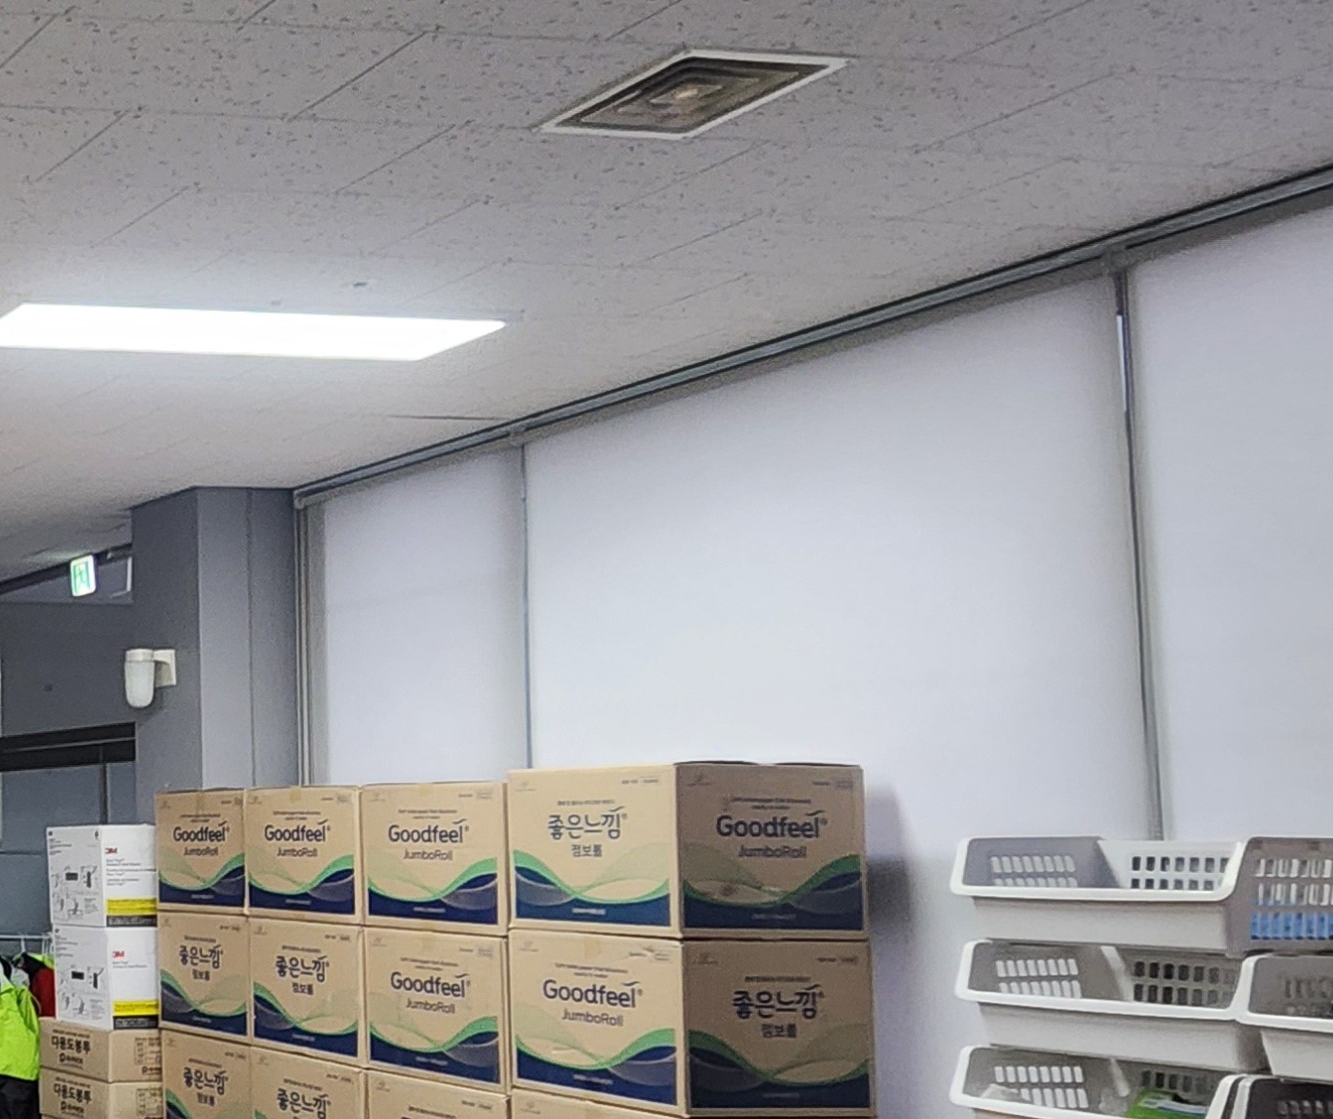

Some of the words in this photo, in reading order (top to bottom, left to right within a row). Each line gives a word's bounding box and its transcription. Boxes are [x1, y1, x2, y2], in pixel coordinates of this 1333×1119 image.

[173, 822, 227, 842] Goodfeel
[264, 820, 326, 842] Goodfeel
[388, 819, 465, 843] Goodfeel
[548, 806, 625, 840] 좋은느낌
[716, 810, 823, 838] Goodfeel
[403, 850, 453, 861] JumboRoll
[571, 844, 603, 858] 점보롤
[738, 845, 807, 858] JumboRoll
[179, 945, 222, 969] 좋은느낌
[275, 956, 328, 982] 좋은느낌
[390, 972, 467, 998] Goodfeel
[543, 979, 639, 1008] Goodfeel
[406, 998, 455, 1014] JumboRoll
[733, 984, 821, 1020] 좋은느낌
[562, 1008, 624, 1027] JumboRoll
[183, 1067, 227, 1095] 좋은느낌
